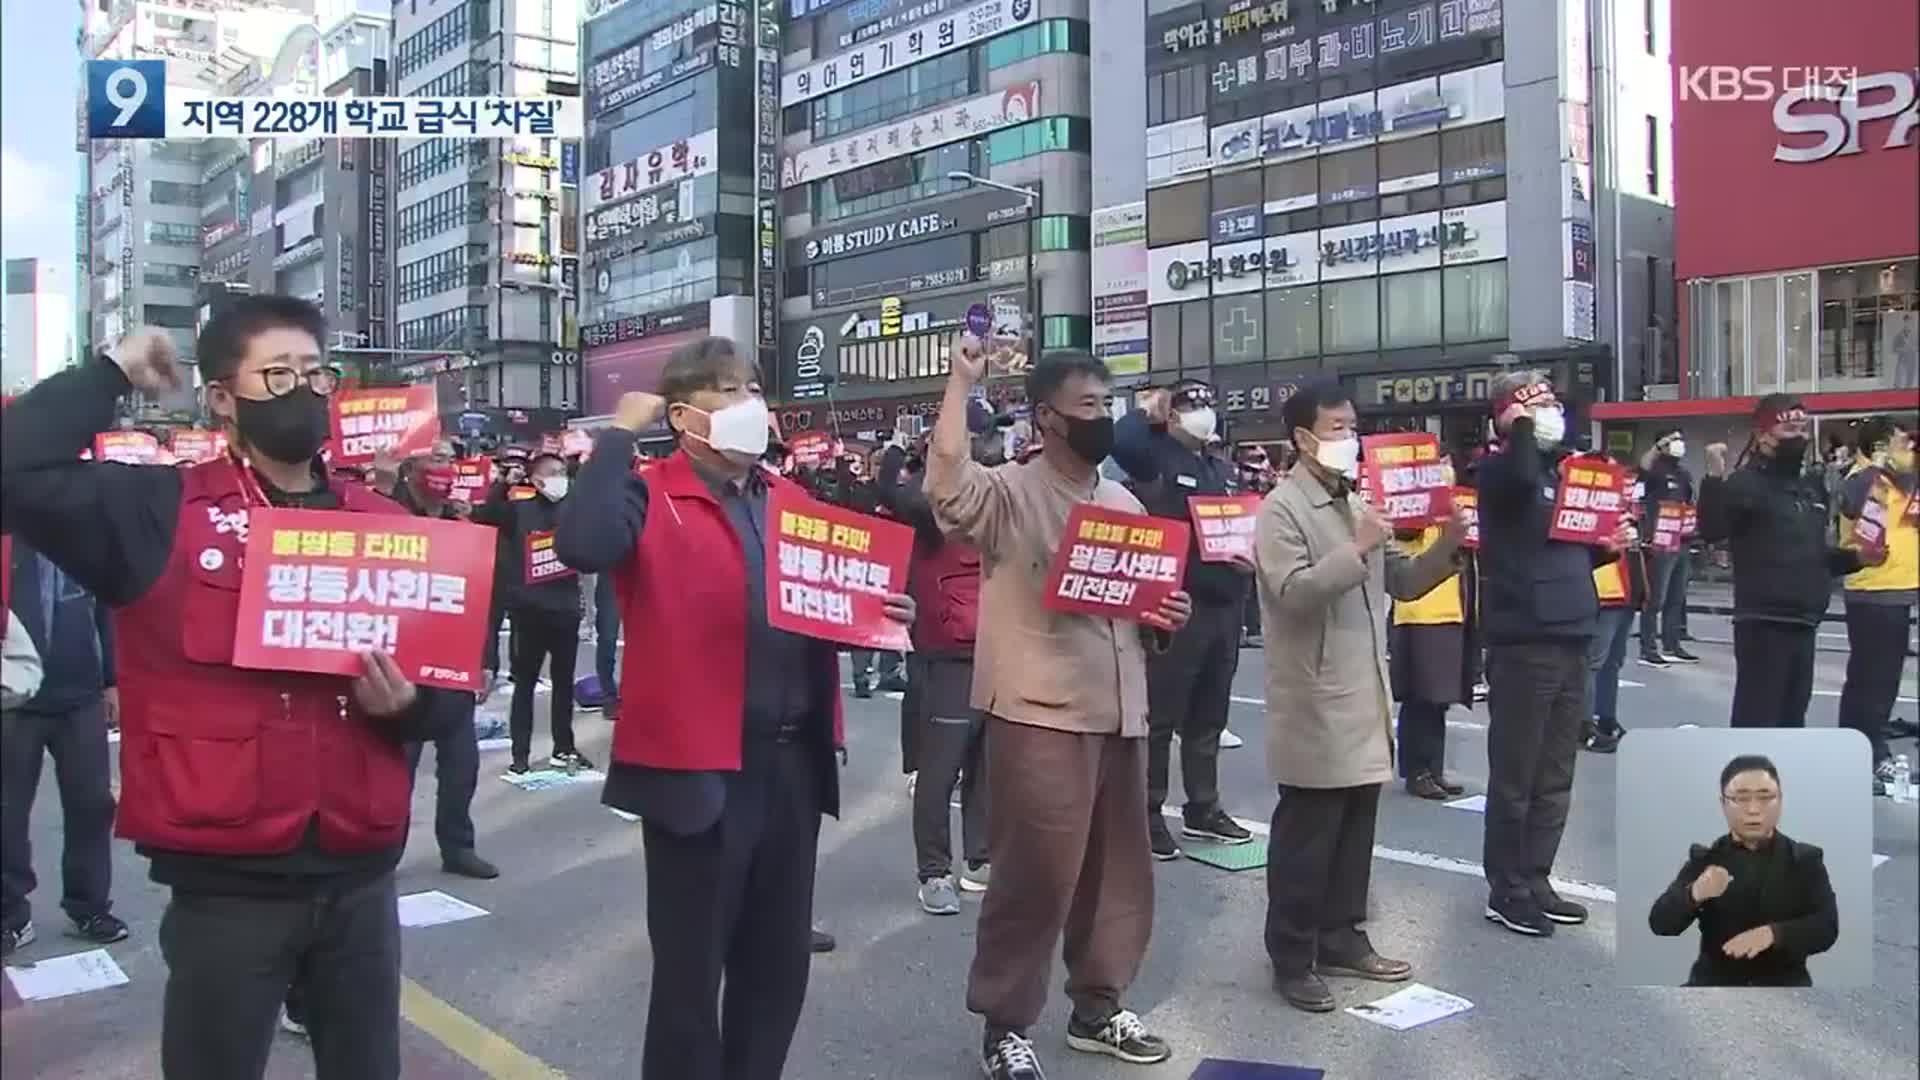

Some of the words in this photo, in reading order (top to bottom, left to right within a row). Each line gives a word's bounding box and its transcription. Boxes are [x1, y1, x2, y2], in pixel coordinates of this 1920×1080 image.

[797, 20, 956, 94] 악어연기학원
[900, 213, 940, 239] CAFE
[1376, 376, 1453, 404] FOOT
[272, 529, 356, 557] 불평등
[781, 510, 829, 544] 불평등
[778, 540, 892, 596] 평등사회로
[1068, 544, 1179, 583] 평등사회로
[267, 564, 467, 615] 평등사회로
[779, 580, 854, 626] 대전환!
[1056, 573, 1138, 606] 대전환!
[261, 609, 399, 655] 대전환!
